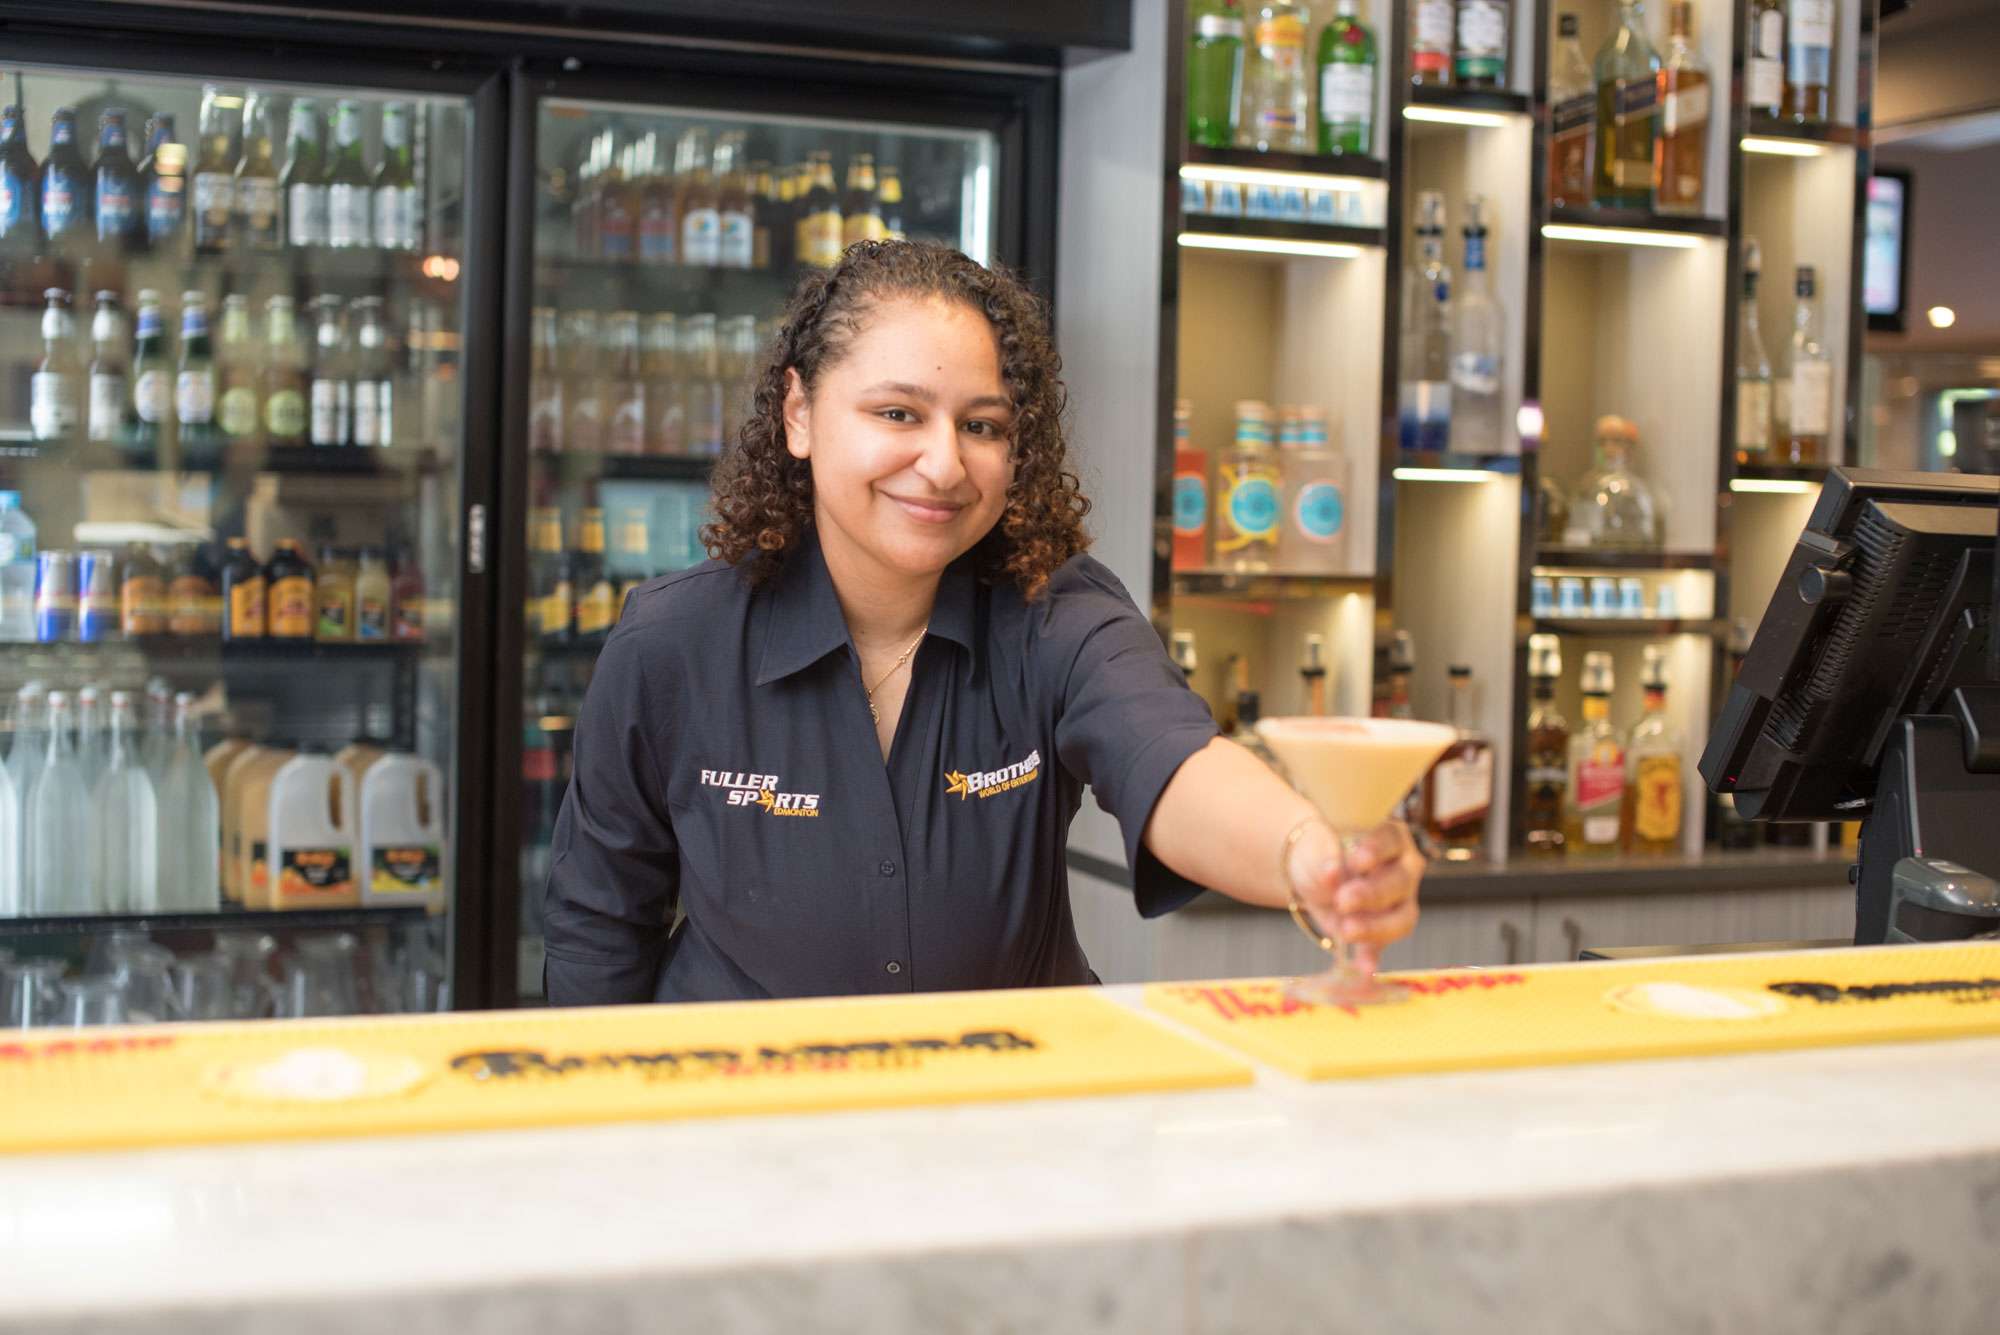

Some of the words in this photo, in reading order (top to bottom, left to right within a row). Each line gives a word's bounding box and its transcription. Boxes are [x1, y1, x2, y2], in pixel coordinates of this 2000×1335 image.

[701, 769, 779, 791] FULLER
[978, 784, 1002, 799] WORLD
[1001, 780, 1011, 792] OF
[773, 808, 819, 817] EDMONTON
